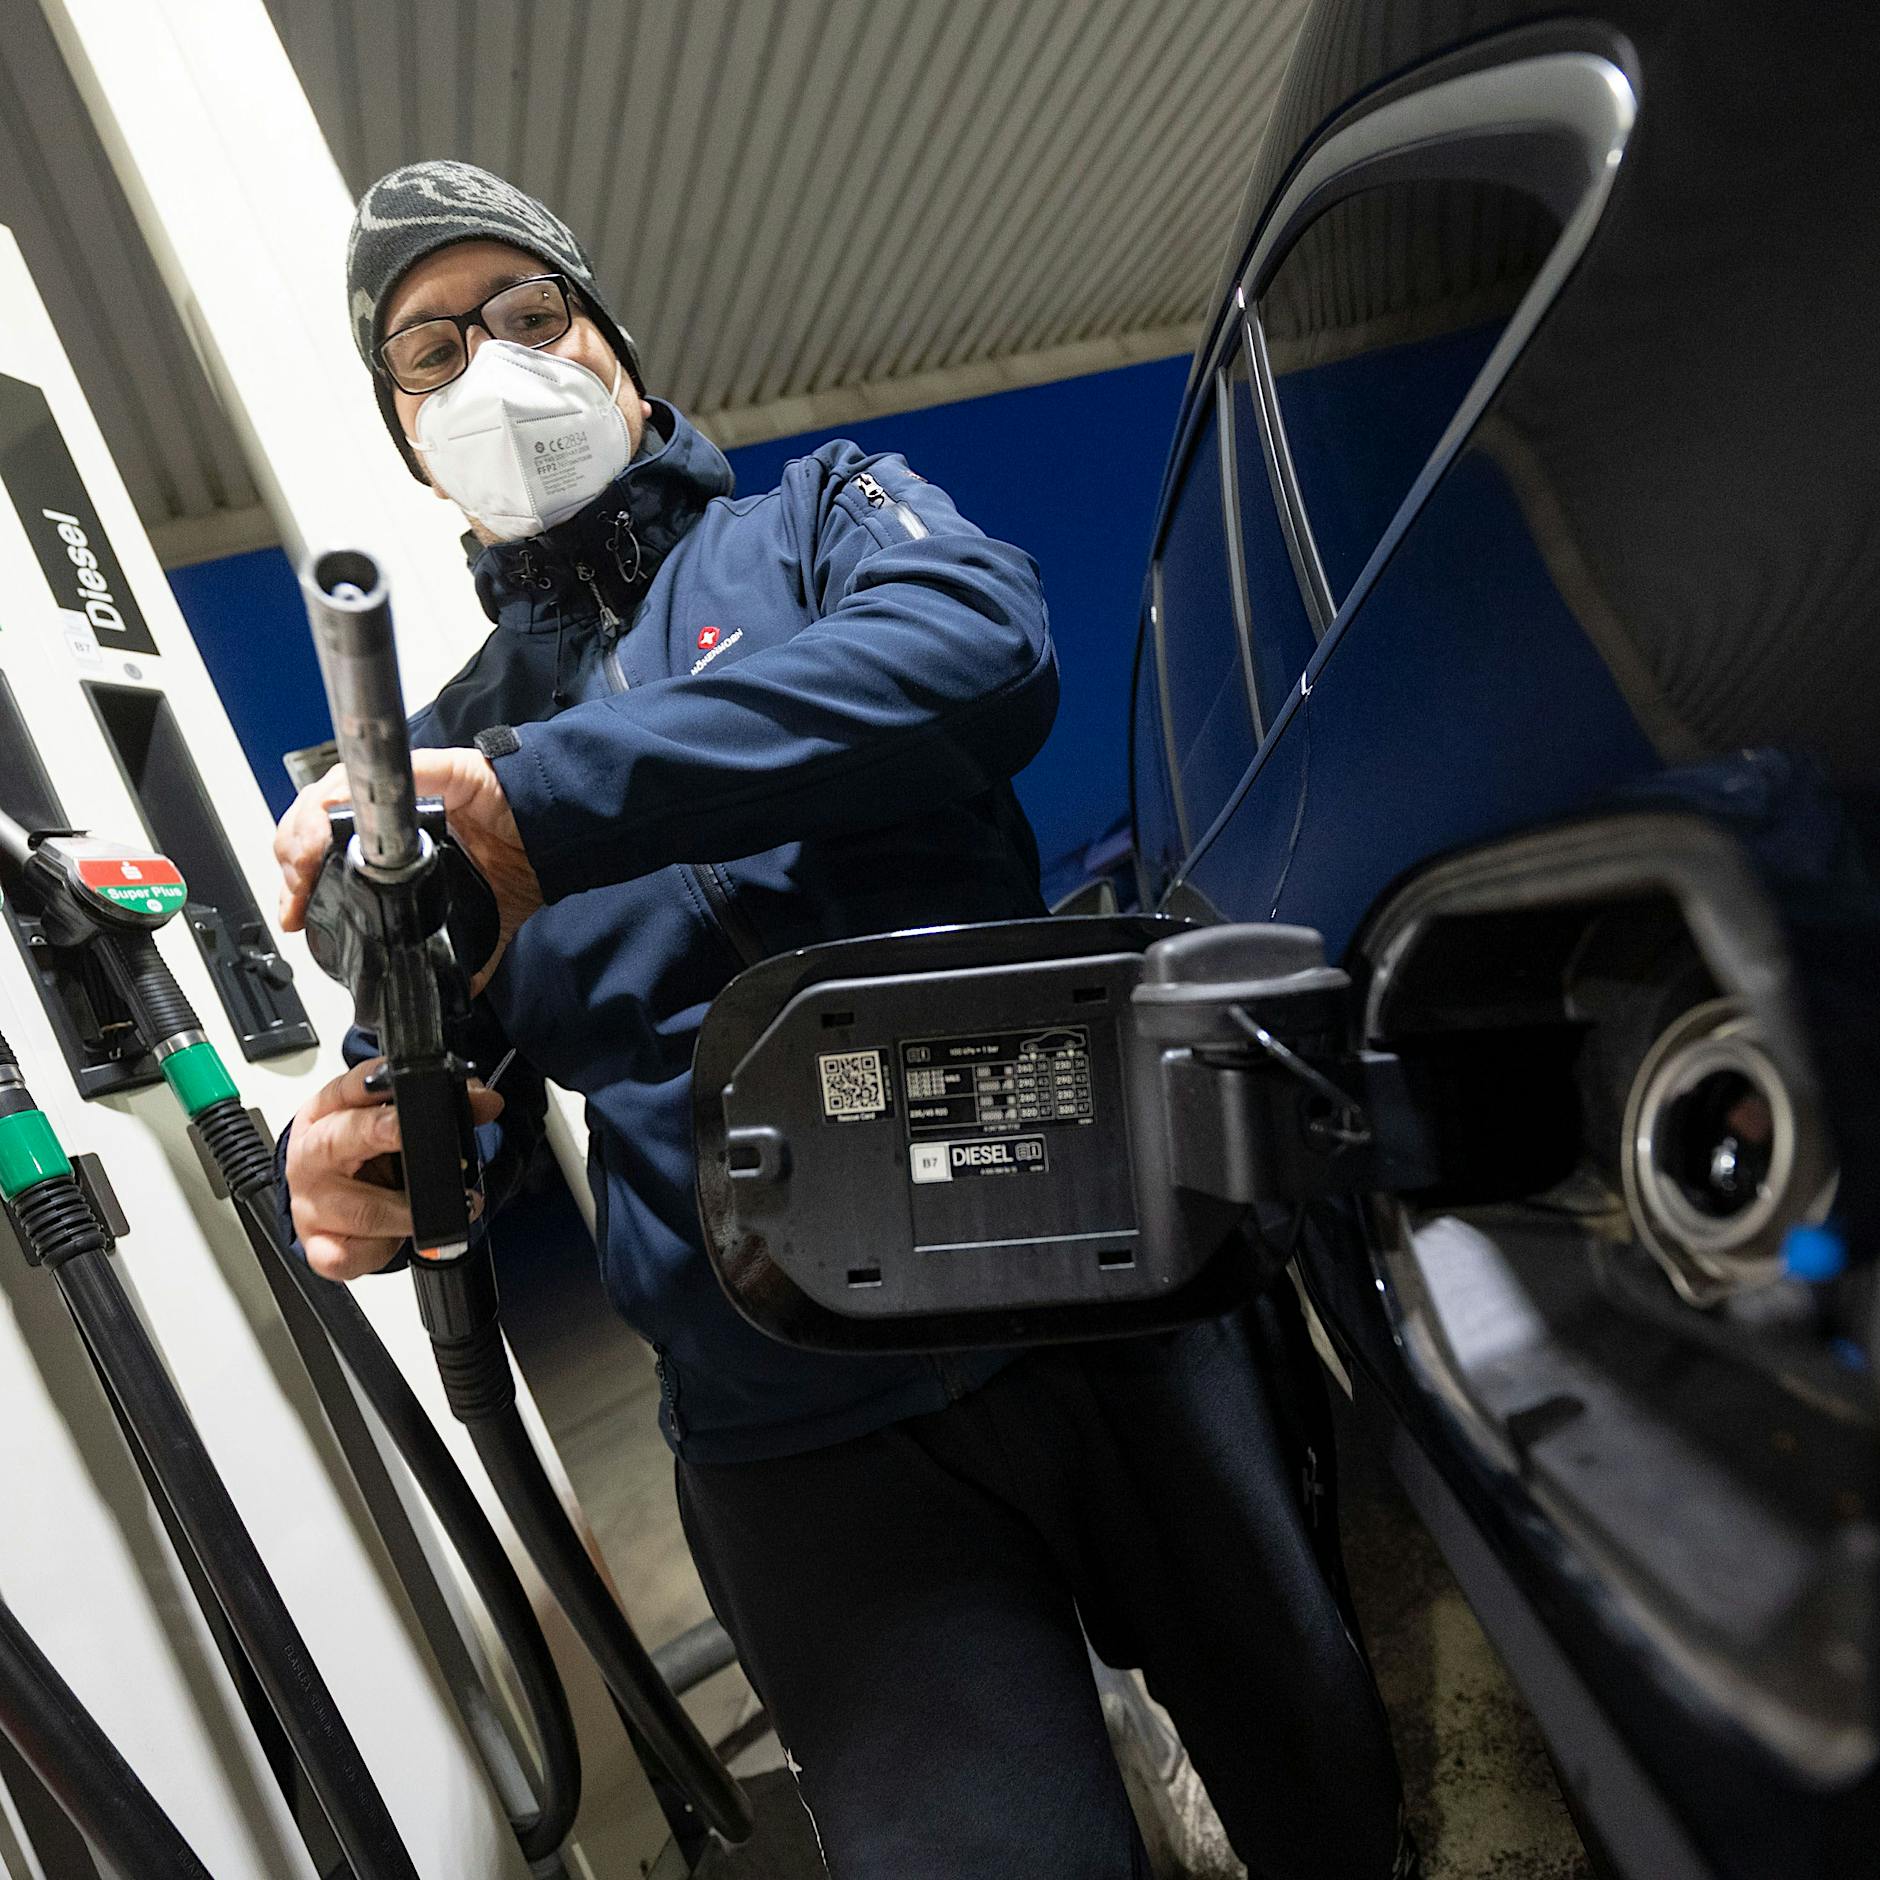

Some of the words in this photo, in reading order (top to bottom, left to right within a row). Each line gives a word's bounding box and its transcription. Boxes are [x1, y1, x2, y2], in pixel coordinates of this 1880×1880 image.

[537, 463, 557, 475] FFP2
[42, 508, 126, 632] Diesel
[107, 888, 150, 901] Super
[150, 886, 183, 897] Plus
[952, 1144, 1014, 1166] DIESEL
[922, 1157, 938, 1169] B7
